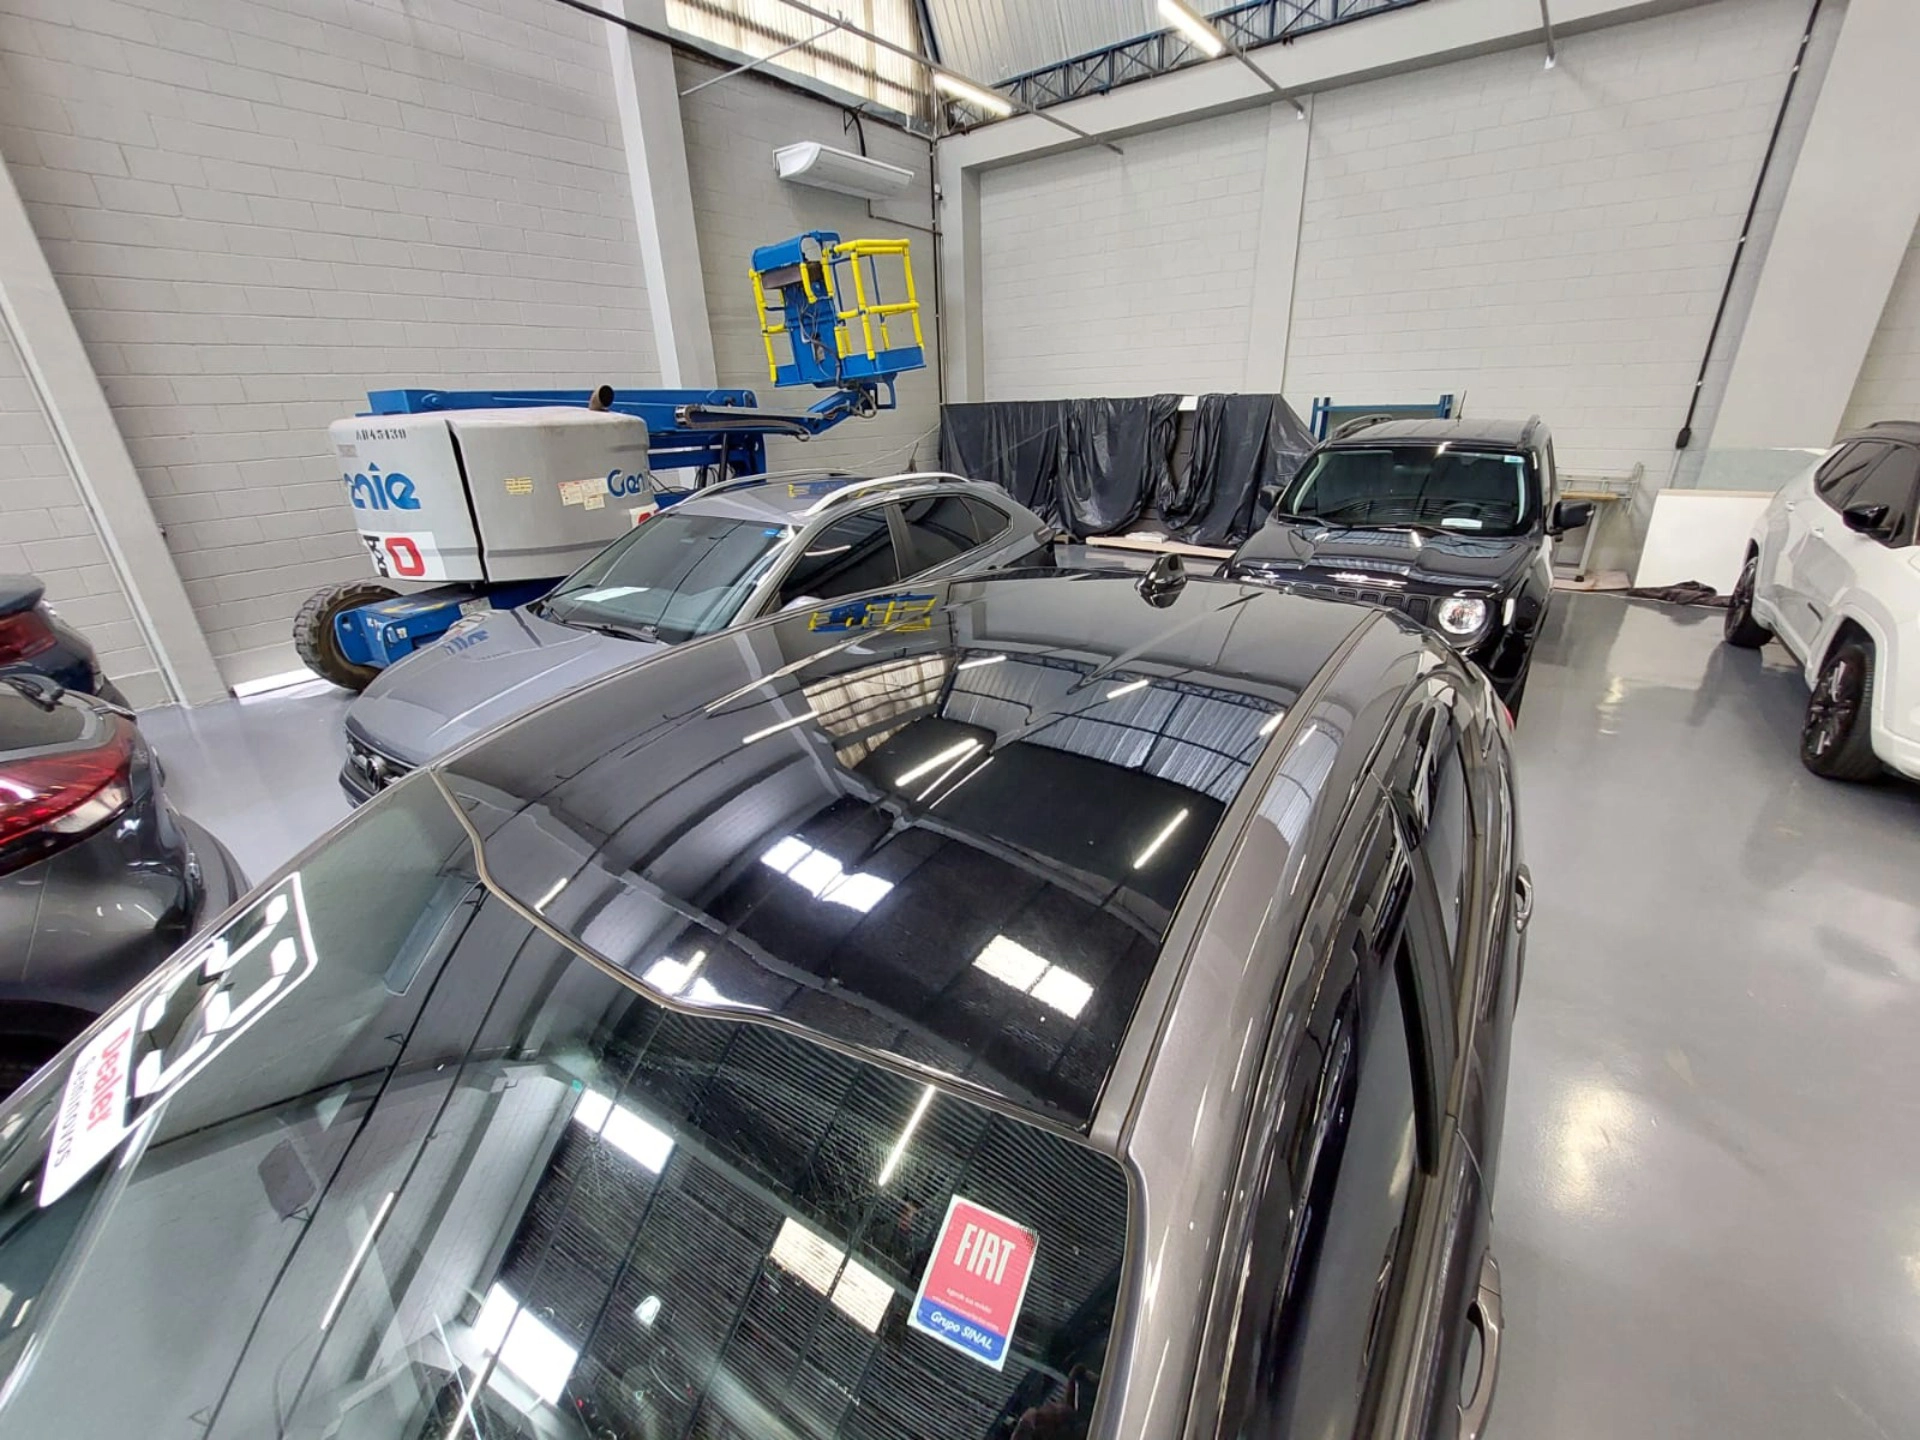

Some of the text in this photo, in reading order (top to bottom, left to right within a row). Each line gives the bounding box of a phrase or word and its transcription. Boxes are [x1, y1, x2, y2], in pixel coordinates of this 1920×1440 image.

[86, 1028, 131, 1131] Dealer
[953, 1223, 1016, 1286] FIAT
[931, 1311, 961, 1333] Grupo
[961, 1326, 994, 1351] SINAL
